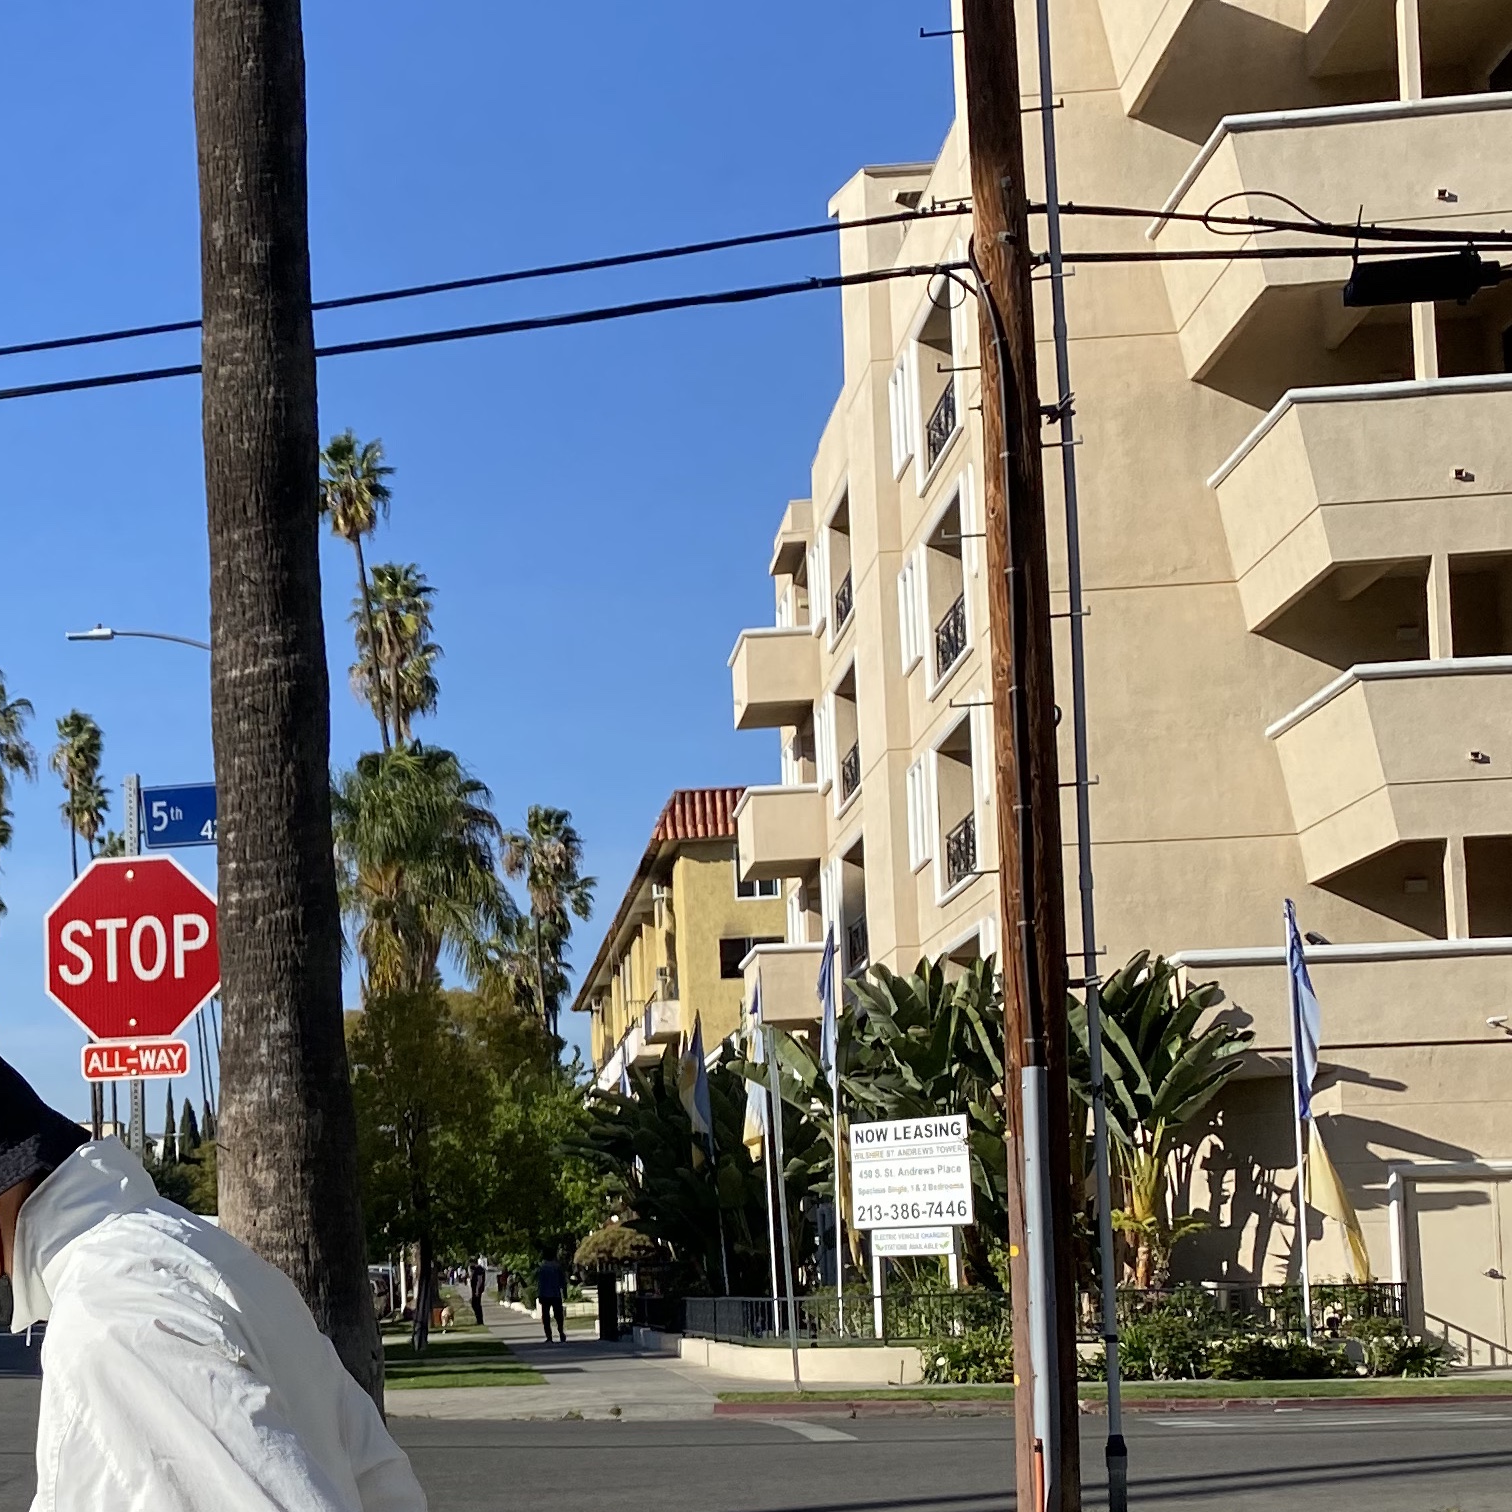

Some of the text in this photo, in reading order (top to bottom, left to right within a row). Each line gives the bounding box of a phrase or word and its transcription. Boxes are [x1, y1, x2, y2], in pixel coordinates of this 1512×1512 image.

[152, 800, 183, 832] 5th
[200, 819, 217, 840] 4
[58, 914, 209, 985] STOP
[87, 1047, 183, 1073] ALL-WAY
[855, 1121, 961, 1144] NOW LEASING
[898, 1146, 934, 1157] ANDREWS
[936, 1144, 967, 1154] TOWERS
[898, 1166, 935, 1177] Andrews
[937, 1164, 962, 1174] Place
[857, 1200, 967, 1222] 213-386-7446
